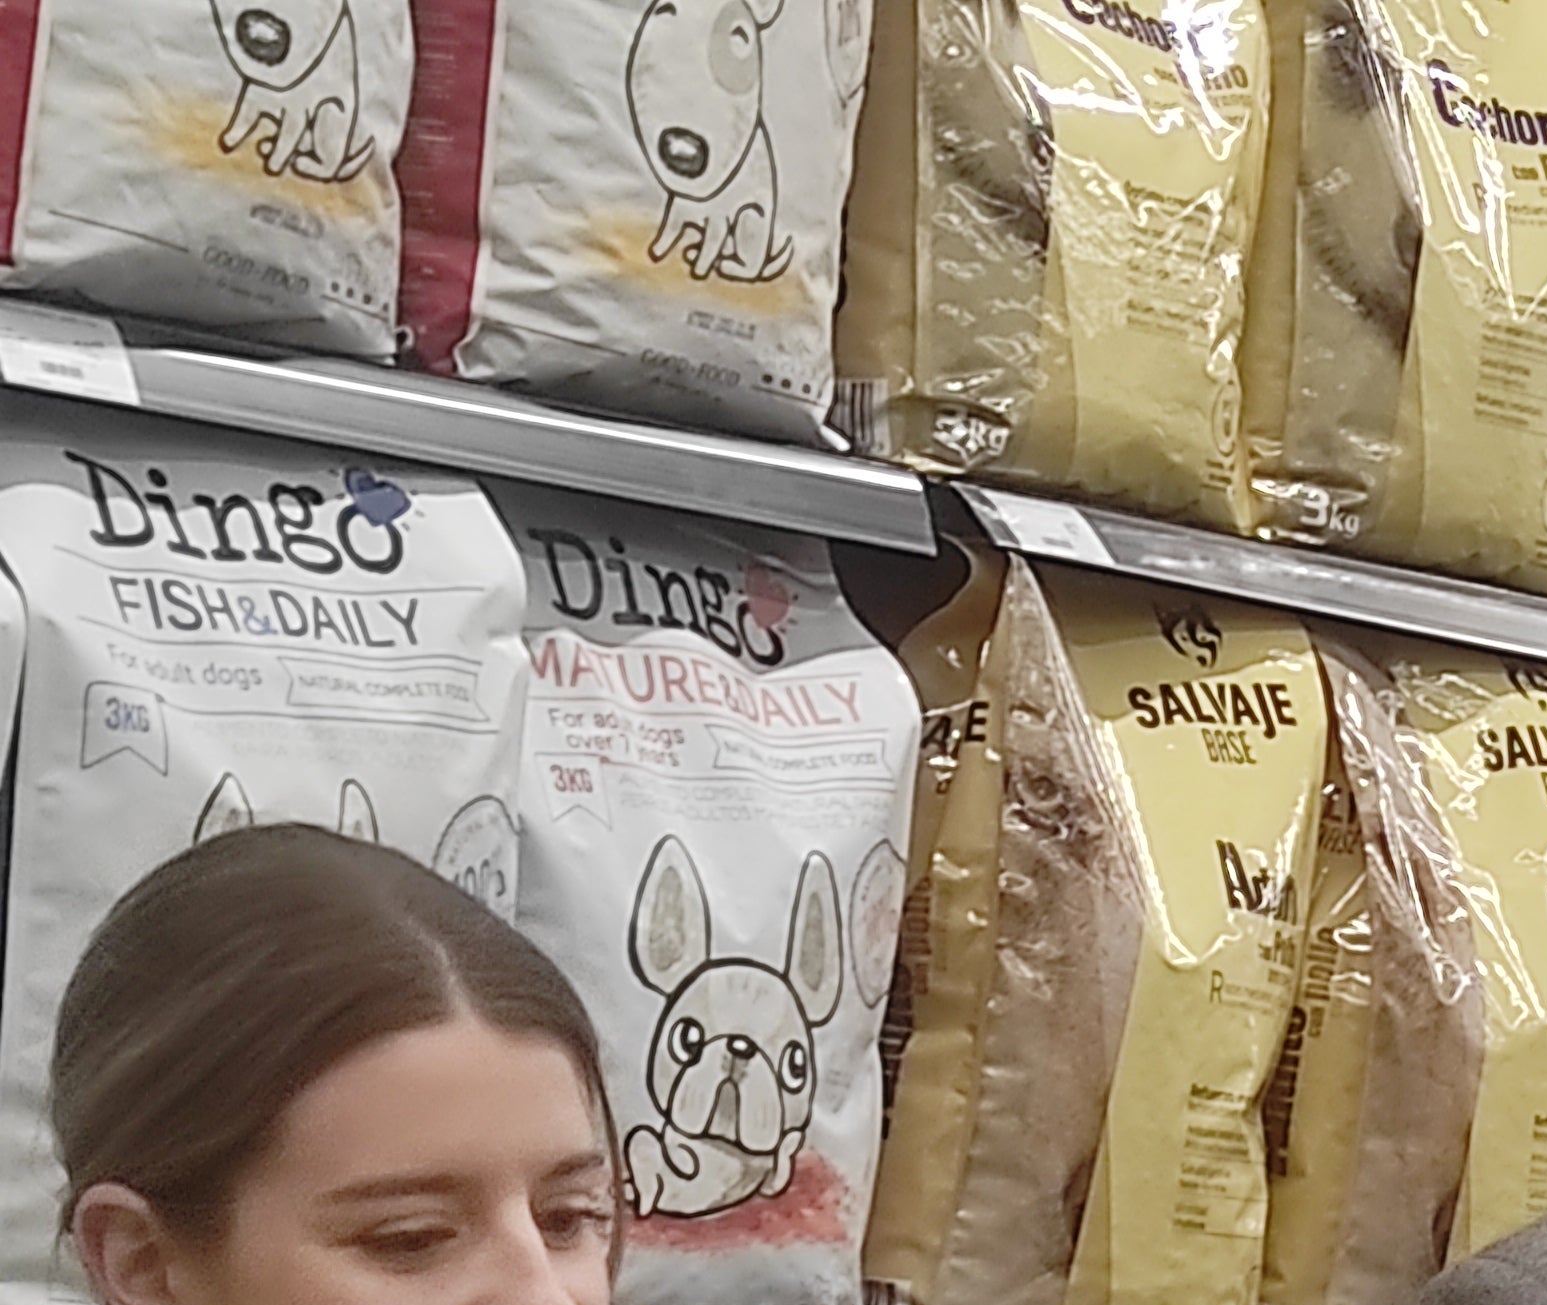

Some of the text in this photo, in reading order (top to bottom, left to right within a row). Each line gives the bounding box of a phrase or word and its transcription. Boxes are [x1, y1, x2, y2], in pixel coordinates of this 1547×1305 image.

[63, 449, 404, 575] Dingo
[108, 575, 420, 648] FISH&DAILY
[527, 526, 786, 666] Dingo
[200, 660, 264, 691] dogs
[528, 636, 863, 729] MATURE&DAILY
[104, 696, 151, 733] 3KG
[547, 707, 584, 729] For
[1127, 681, 1298, 740] SALVAJE
[1201, 729, 1258, 765] BASE
[549, 764, 594, 793] 3KG
